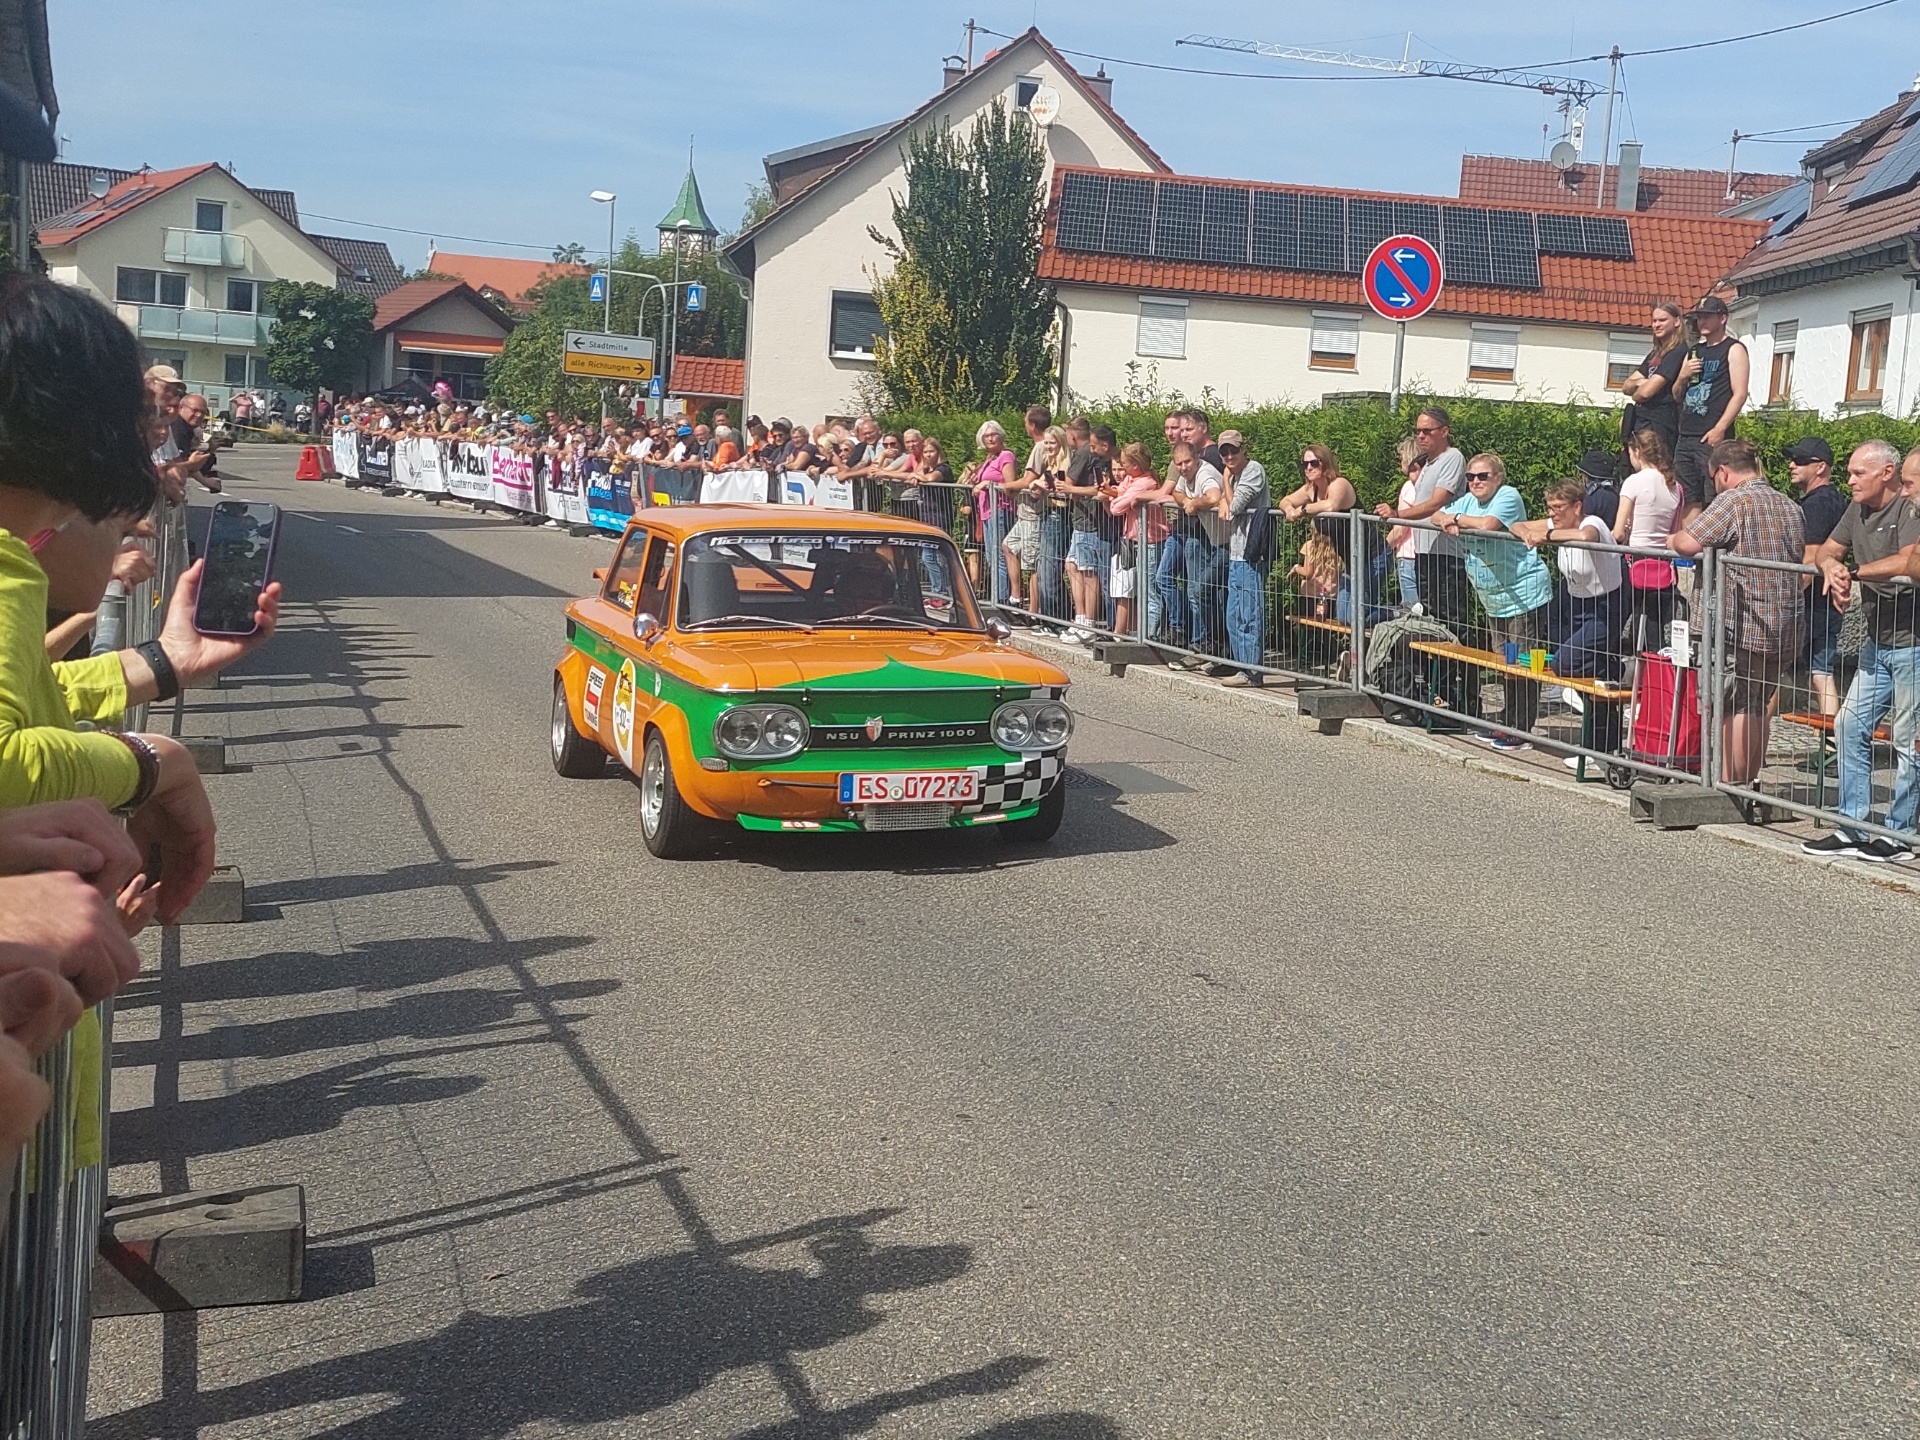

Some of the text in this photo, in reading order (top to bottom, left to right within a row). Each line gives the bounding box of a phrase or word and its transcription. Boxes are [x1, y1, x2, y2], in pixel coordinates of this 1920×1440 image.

[588, 341, 629, 352] Stadtmitte
[588, 360, 631, 372] Richtungen
[838, 536, 884, 545] Corse
[826, 729, 976, 740] NSU PRINZ 1000
[858, 775, 973, 800] ES 07273
